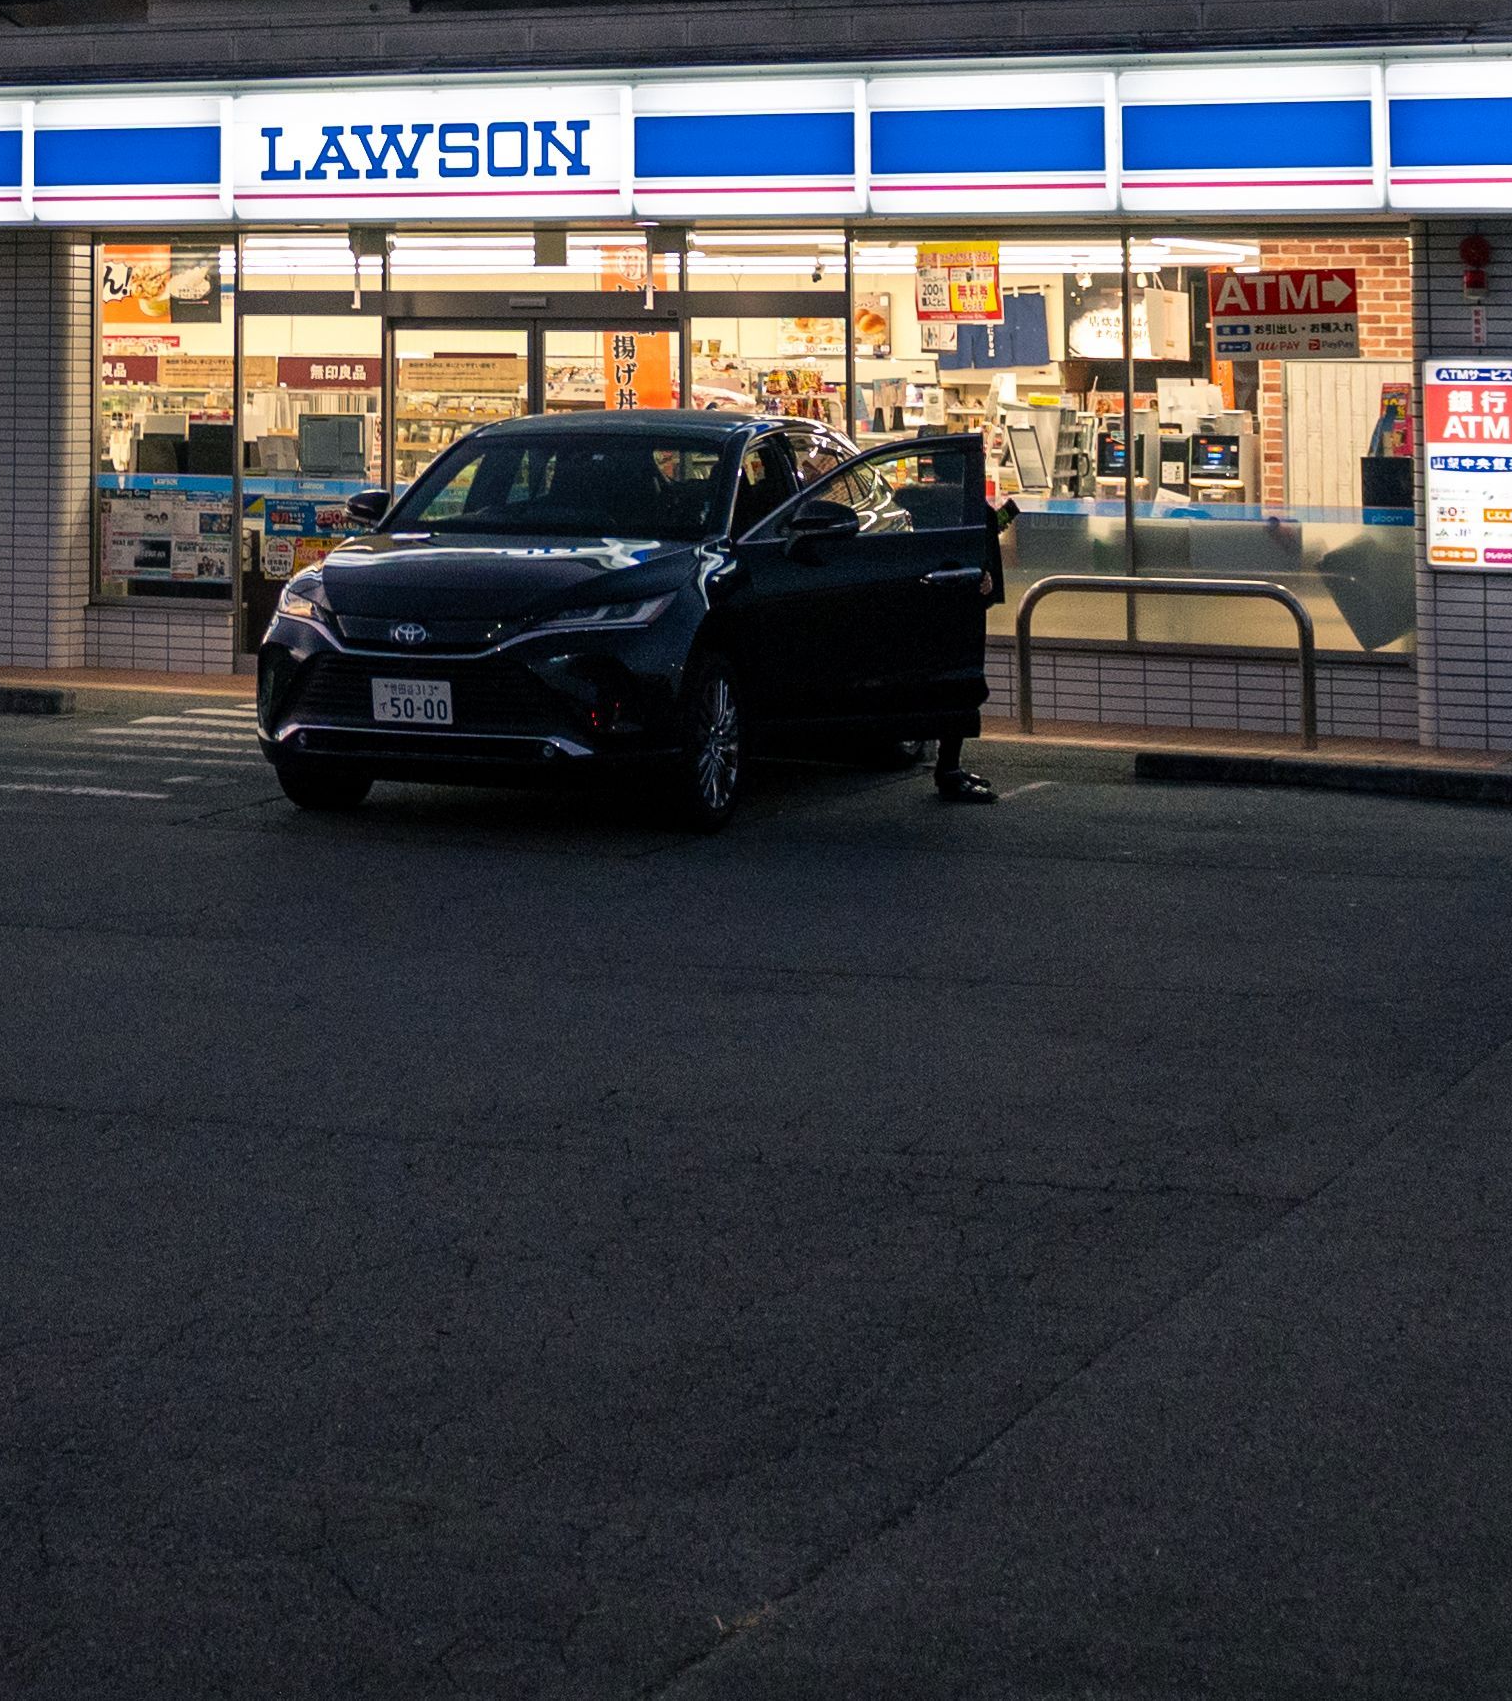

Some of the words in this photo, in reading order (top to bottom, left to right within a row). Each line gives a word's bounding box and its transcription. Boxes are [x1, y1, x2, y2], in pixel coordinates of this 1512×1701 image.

[261, 120, 590, 180] LAWSON
[1215, 274, 1319, 312] ATM
[1279, 341, 1300, 350] PAY
[310, 363, 367, 381] 無印良品
[1448, 390, 1507, 414] 銀行
[1442, 415, 1510, 440] ATM
[390, 697, 448, 721] 50-00
